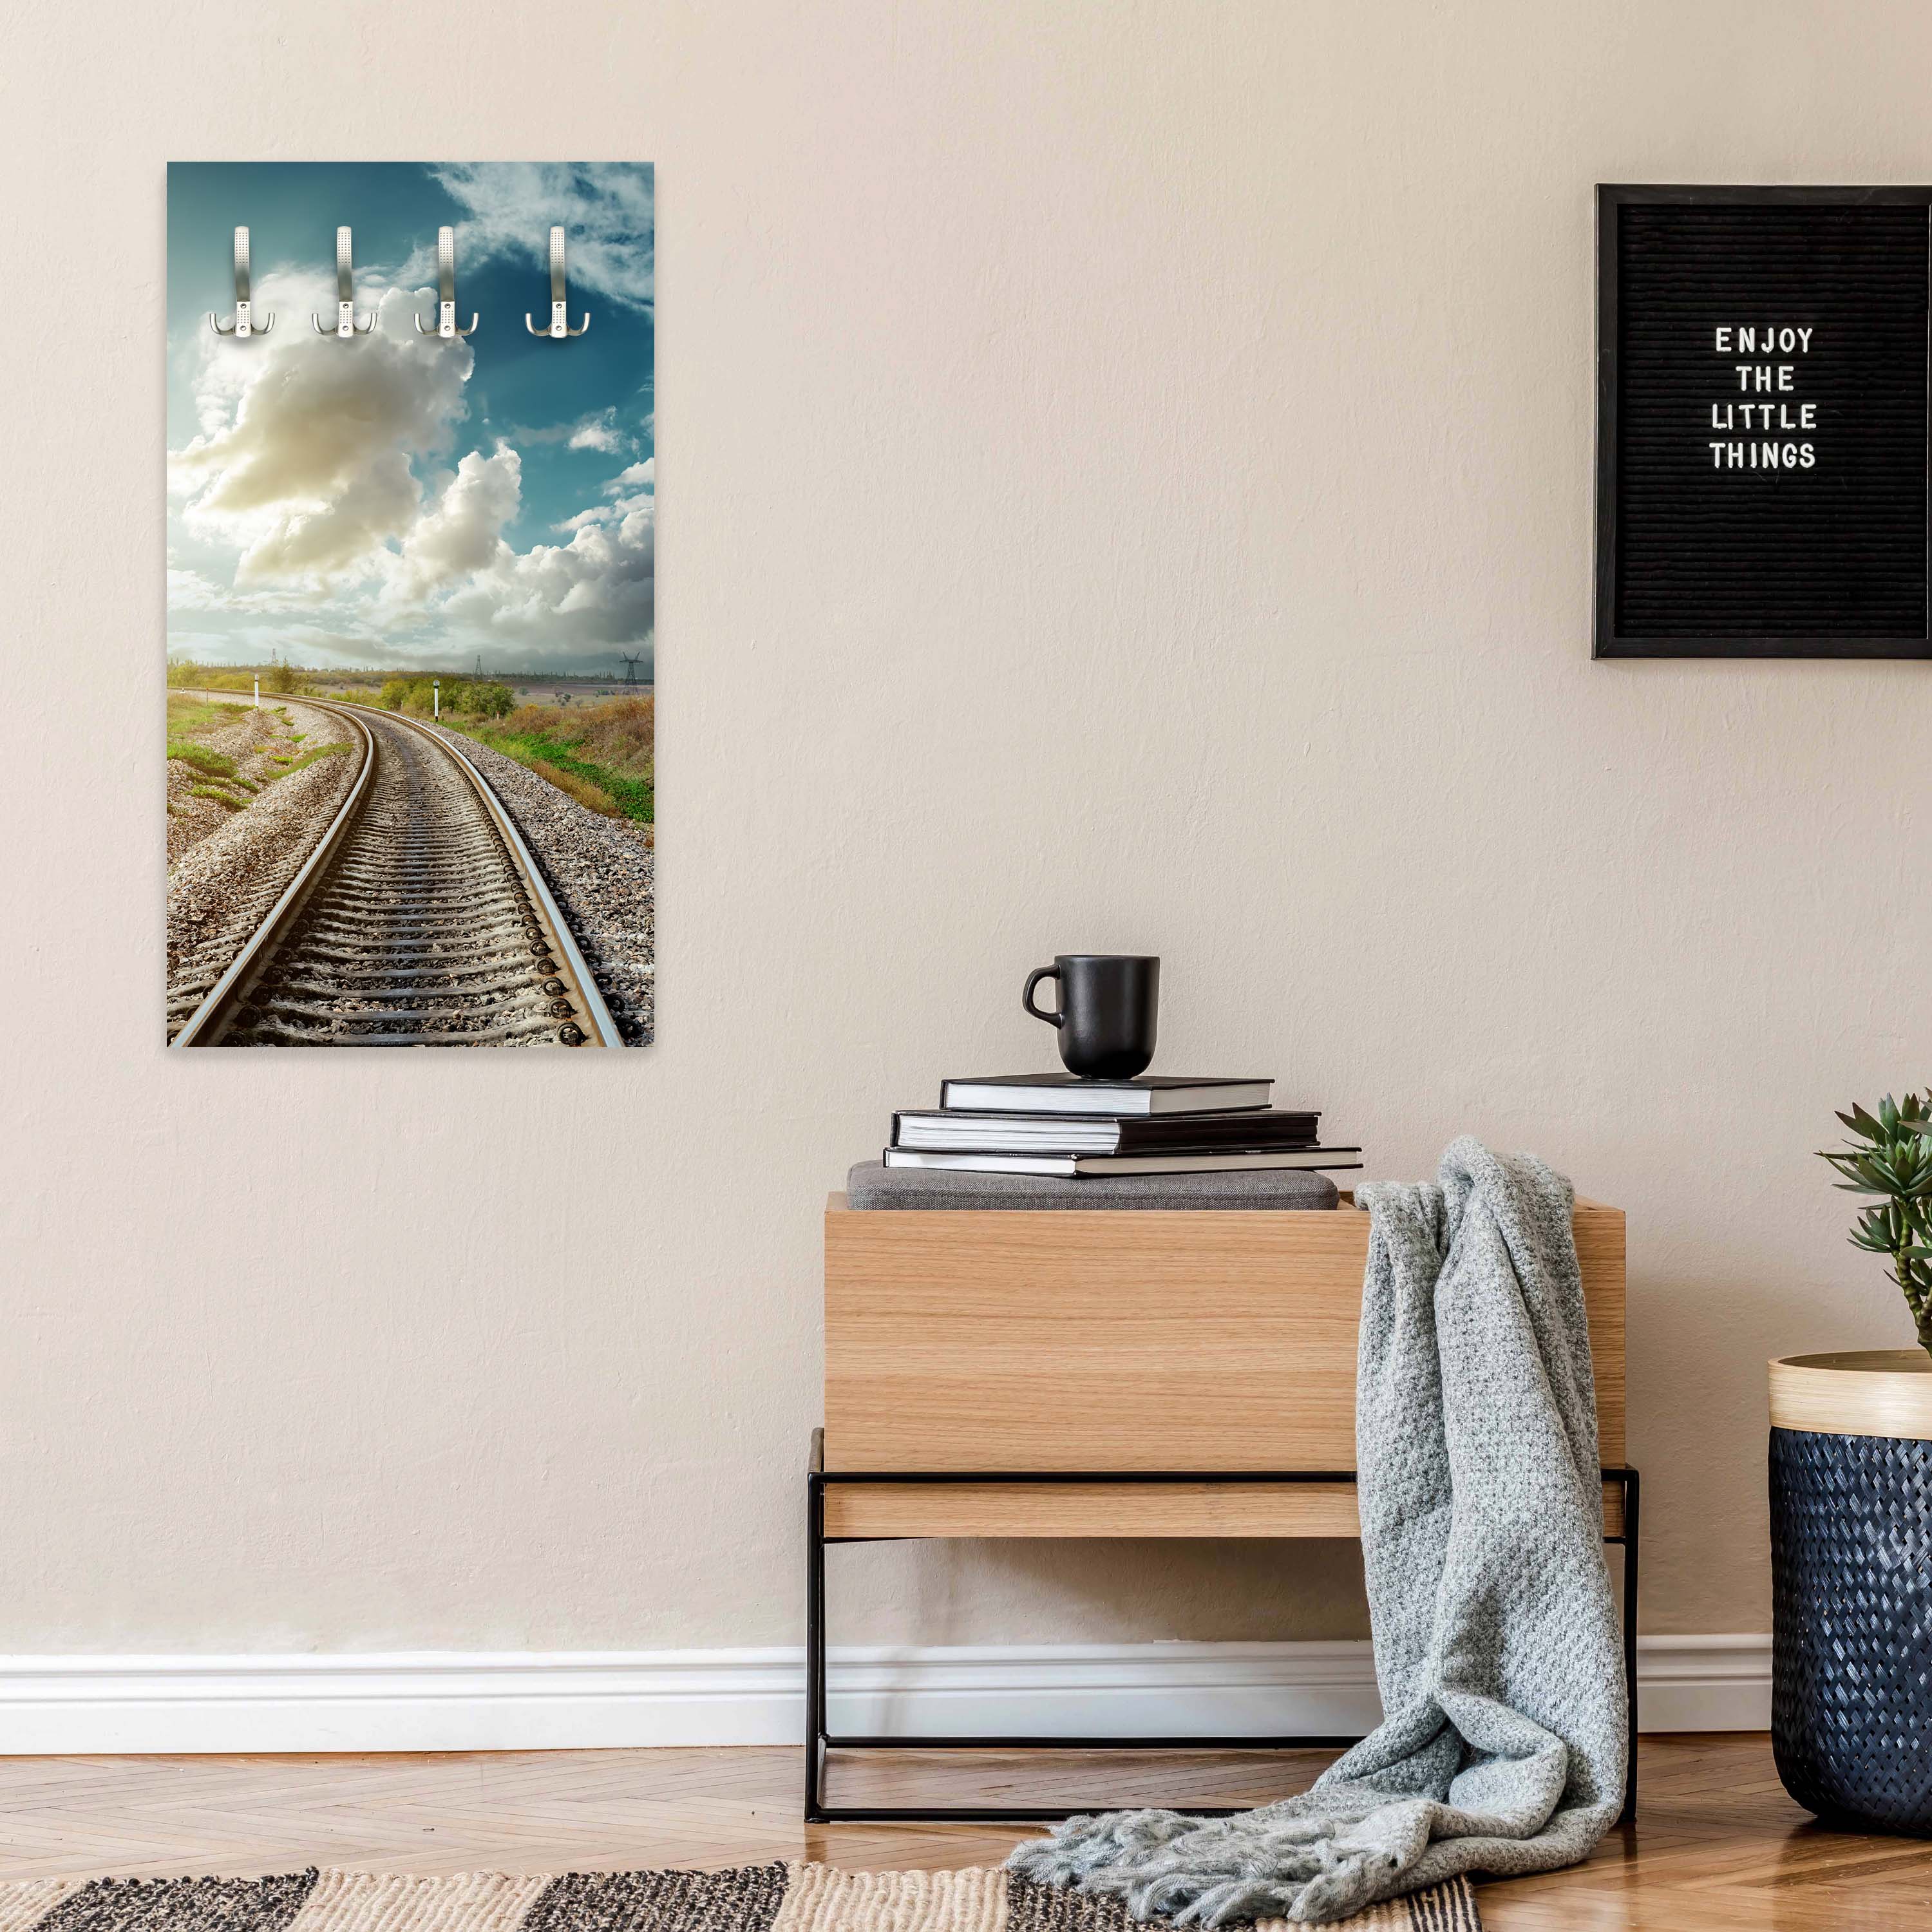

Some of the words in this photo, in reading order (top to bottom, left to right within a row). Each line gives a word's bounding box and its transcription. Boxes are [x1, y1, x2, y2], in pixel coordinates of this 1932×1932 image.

[1716, 327, 1813, 354] ENJOY
[1735, 365, 1794, 392] THE
[1712, 403, 1817, 430] LITTLE
[1709, 442, 1815, 469] THINGS
